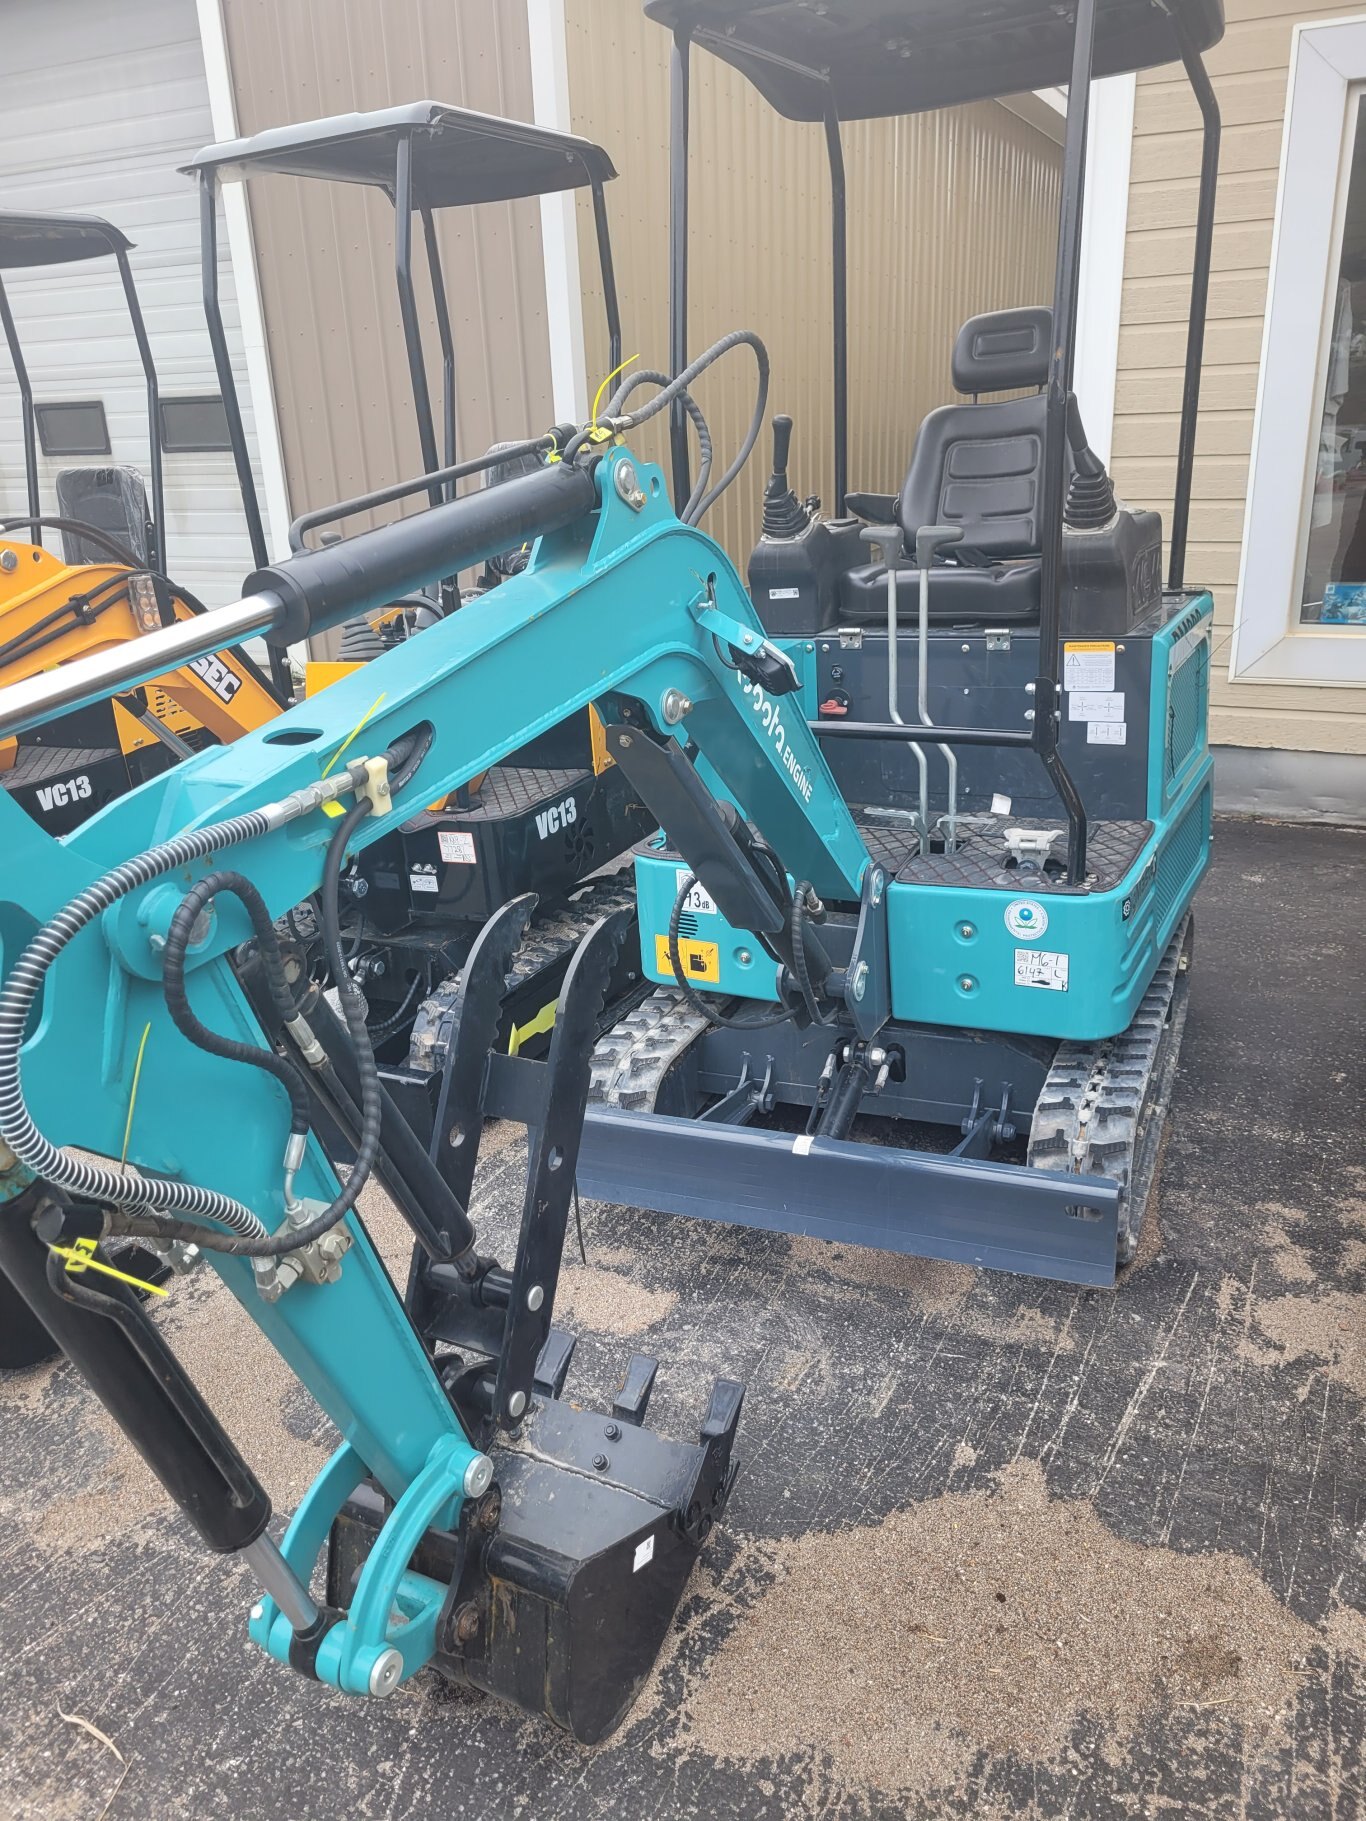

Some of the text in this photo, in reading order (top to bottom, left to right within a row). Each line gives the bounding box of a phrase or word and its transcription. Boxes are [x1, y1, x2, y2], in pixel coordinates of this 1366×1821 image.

[36, 775, 92, 811] VC13
[782, 745, 813, 803] ENGINE
[535, 797, 577, 840] VC13
